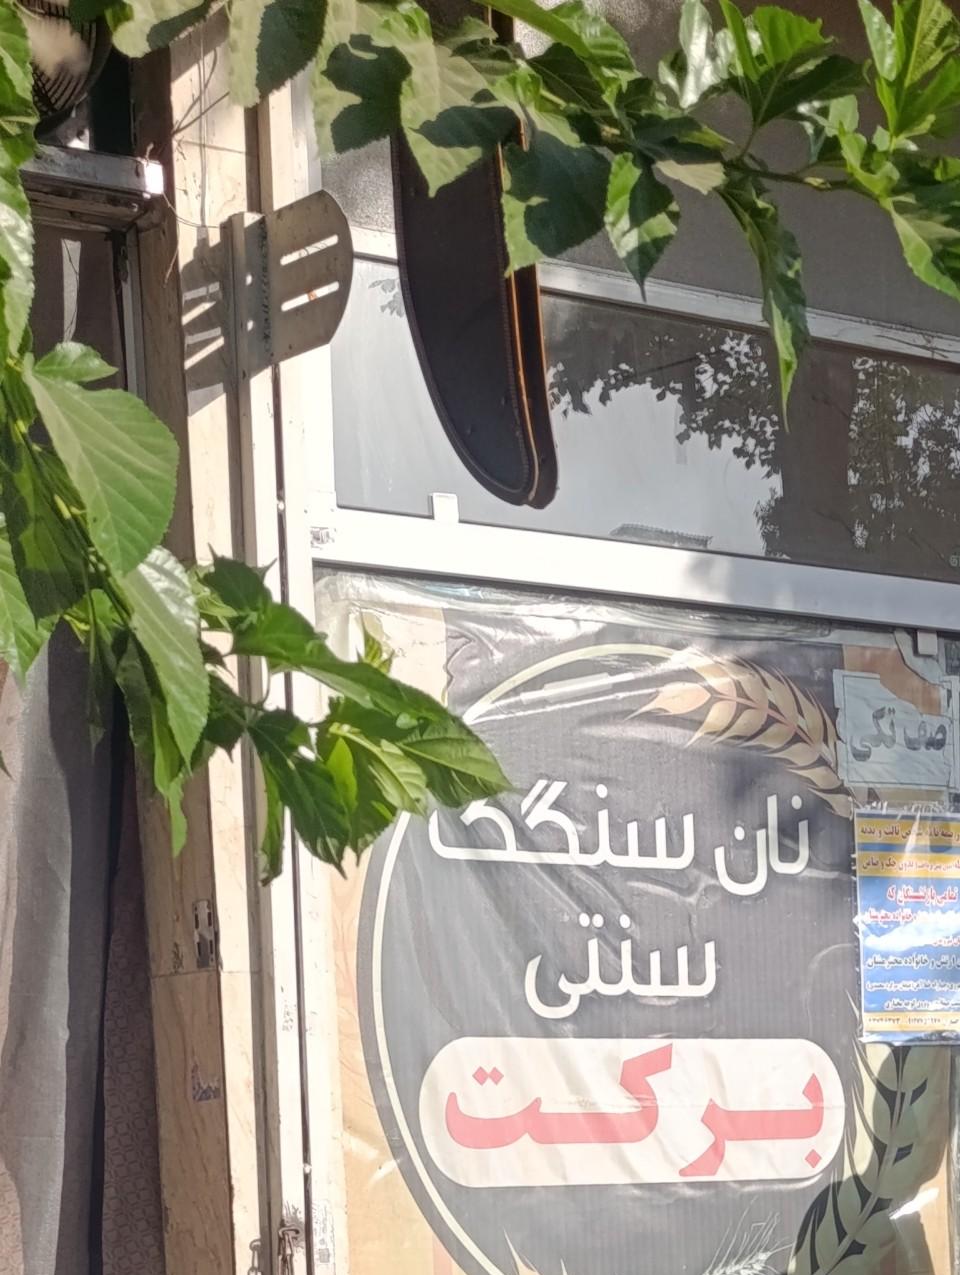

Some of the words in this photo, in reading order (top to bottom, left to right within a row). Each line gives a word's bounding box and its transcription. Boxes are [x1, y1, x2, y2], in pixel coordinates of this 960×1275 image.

[428, 779, 695, 871] سنگک
[713, 793, 810, 896] نان
[523, 912, 718, 1019] سنتی
[445, 1040, 825, 1177] برکت
